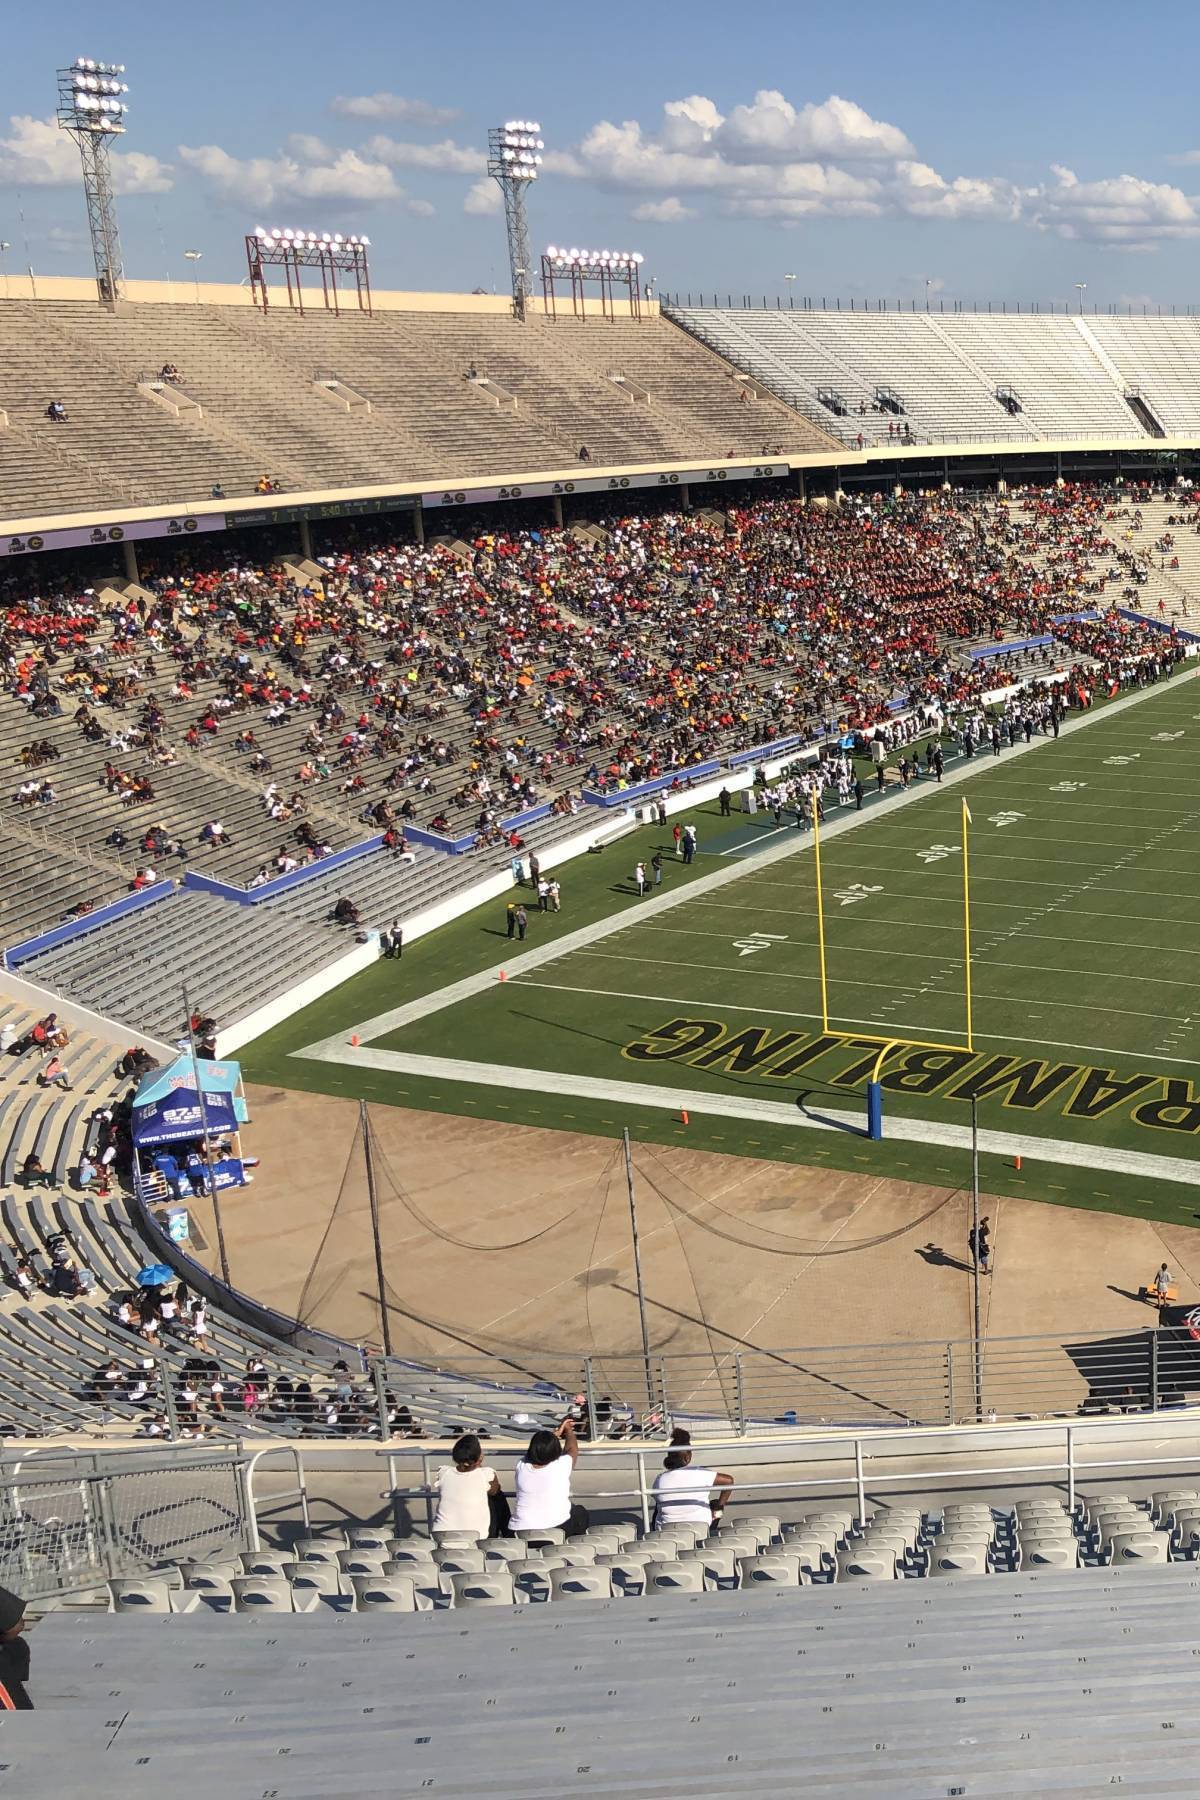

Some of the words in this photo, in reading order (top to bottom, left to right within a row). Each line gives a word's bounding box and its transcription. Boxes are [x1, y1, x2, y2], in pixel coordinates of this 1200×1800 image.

[916, 844, 963, 859] 30
[833, 883, 885, 901] 20
[732, 931, 790, 951] 10
